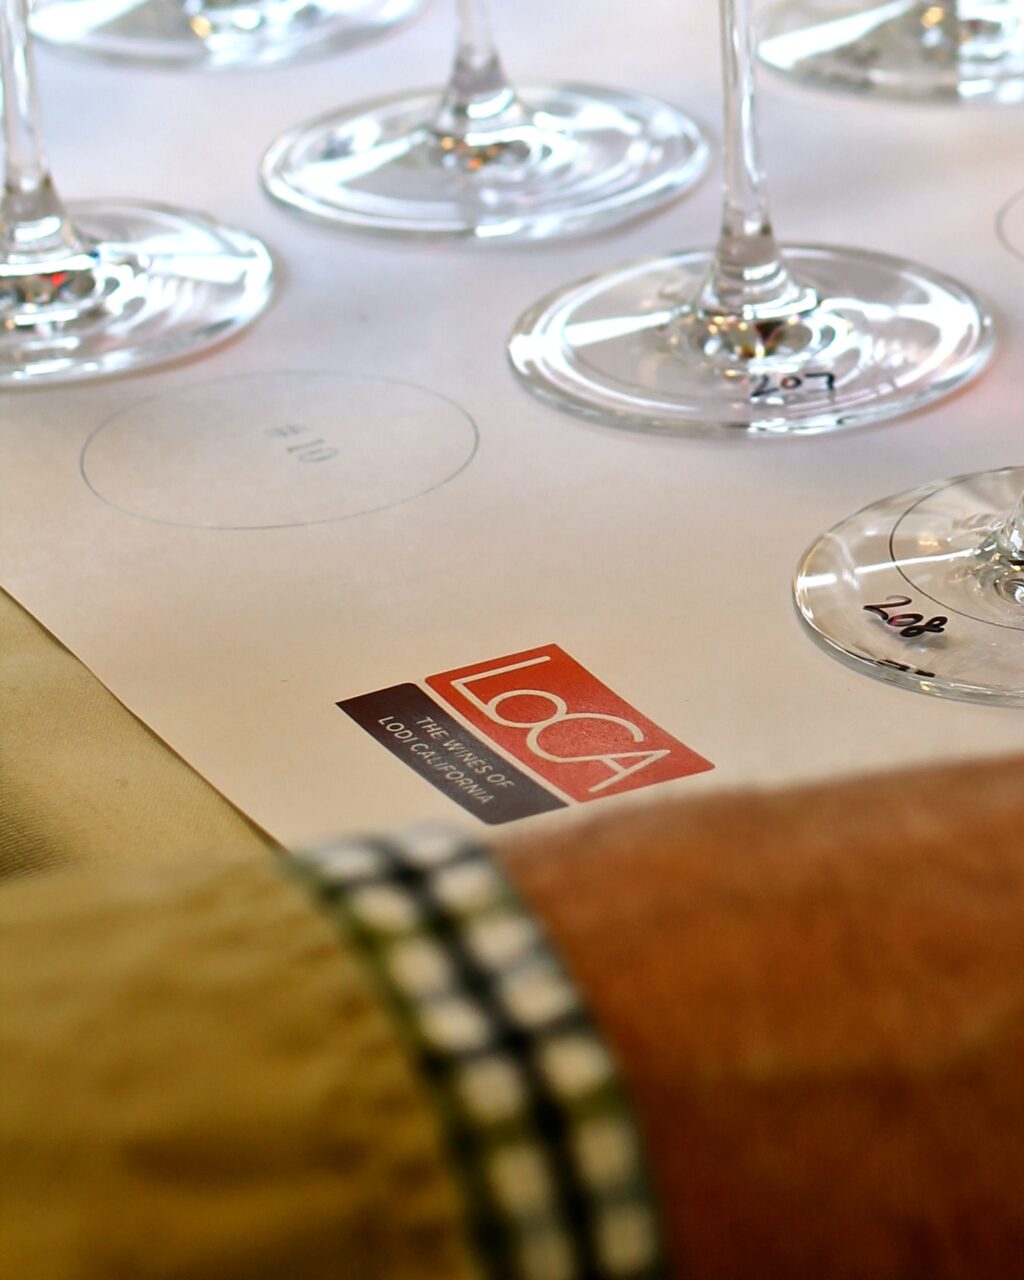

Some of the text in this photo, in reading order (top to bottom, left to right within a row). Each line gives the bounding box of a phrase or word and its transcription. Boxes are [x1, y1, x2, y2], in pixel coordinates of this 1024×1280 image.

[751, 371, 835, 398] 207
[863, 594, 948, 638] 208
[378, 715, 494, 804] LODI CALIFORNIA
[416, 715, 516, 788] THE WINES OF
[451, 655, 671, 792] LOCA
